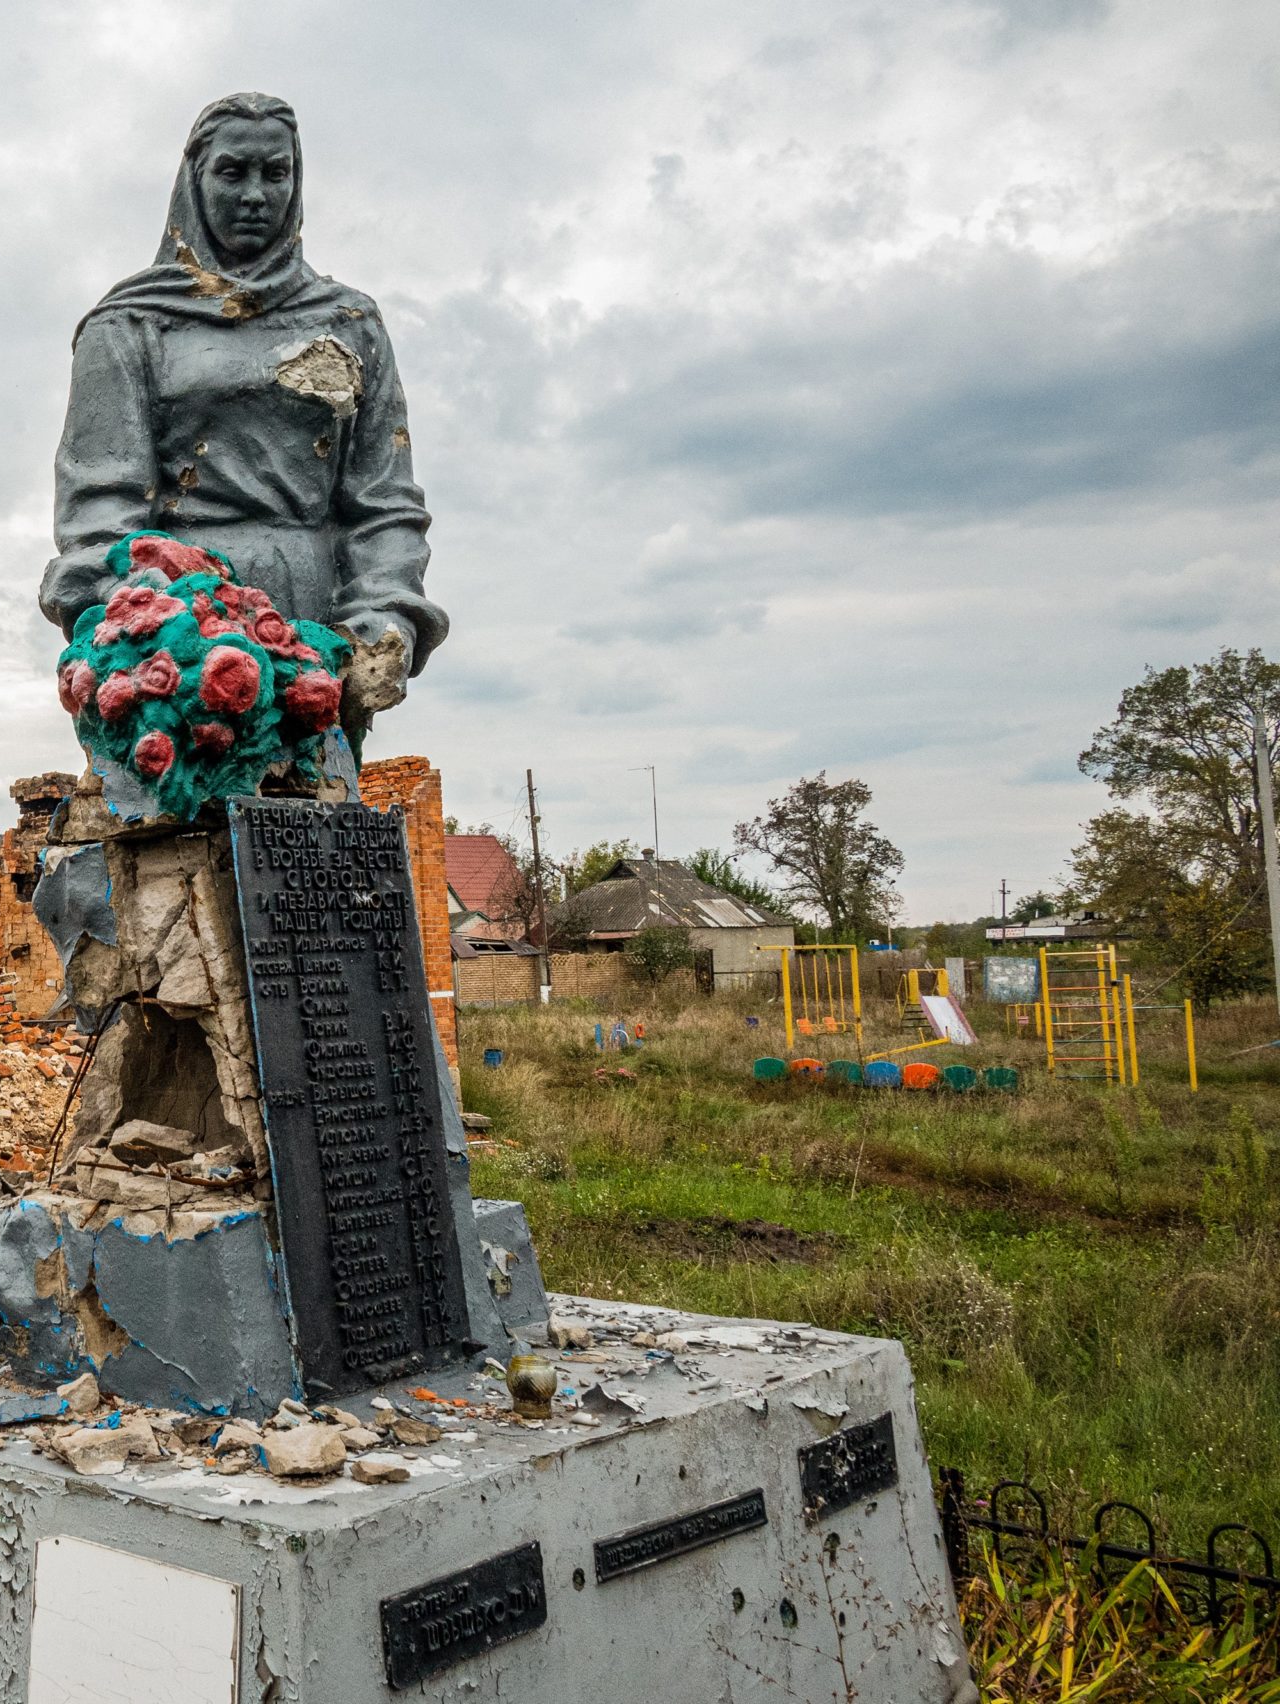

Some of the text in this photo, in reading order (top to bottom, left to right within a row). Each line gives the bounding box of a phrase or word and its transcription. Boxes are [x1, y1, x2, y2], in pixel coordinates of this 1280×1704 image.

[249, 806, 398, 829] ВЕЧНАЯ СЛАВА
[252, 827, 401, 848] ГЕРОЯМ ПАВШИМ
[254, 848, 403, 868] В БОРЬБЕ ЗА ЧЕСТЬ
[286, 870, 379, 887] СВОБОДУ
[259, 891, 410, 909] И НЕЗАВИСИМОСТЬ
[271, 911, 329, 930] НАШЕЙ
